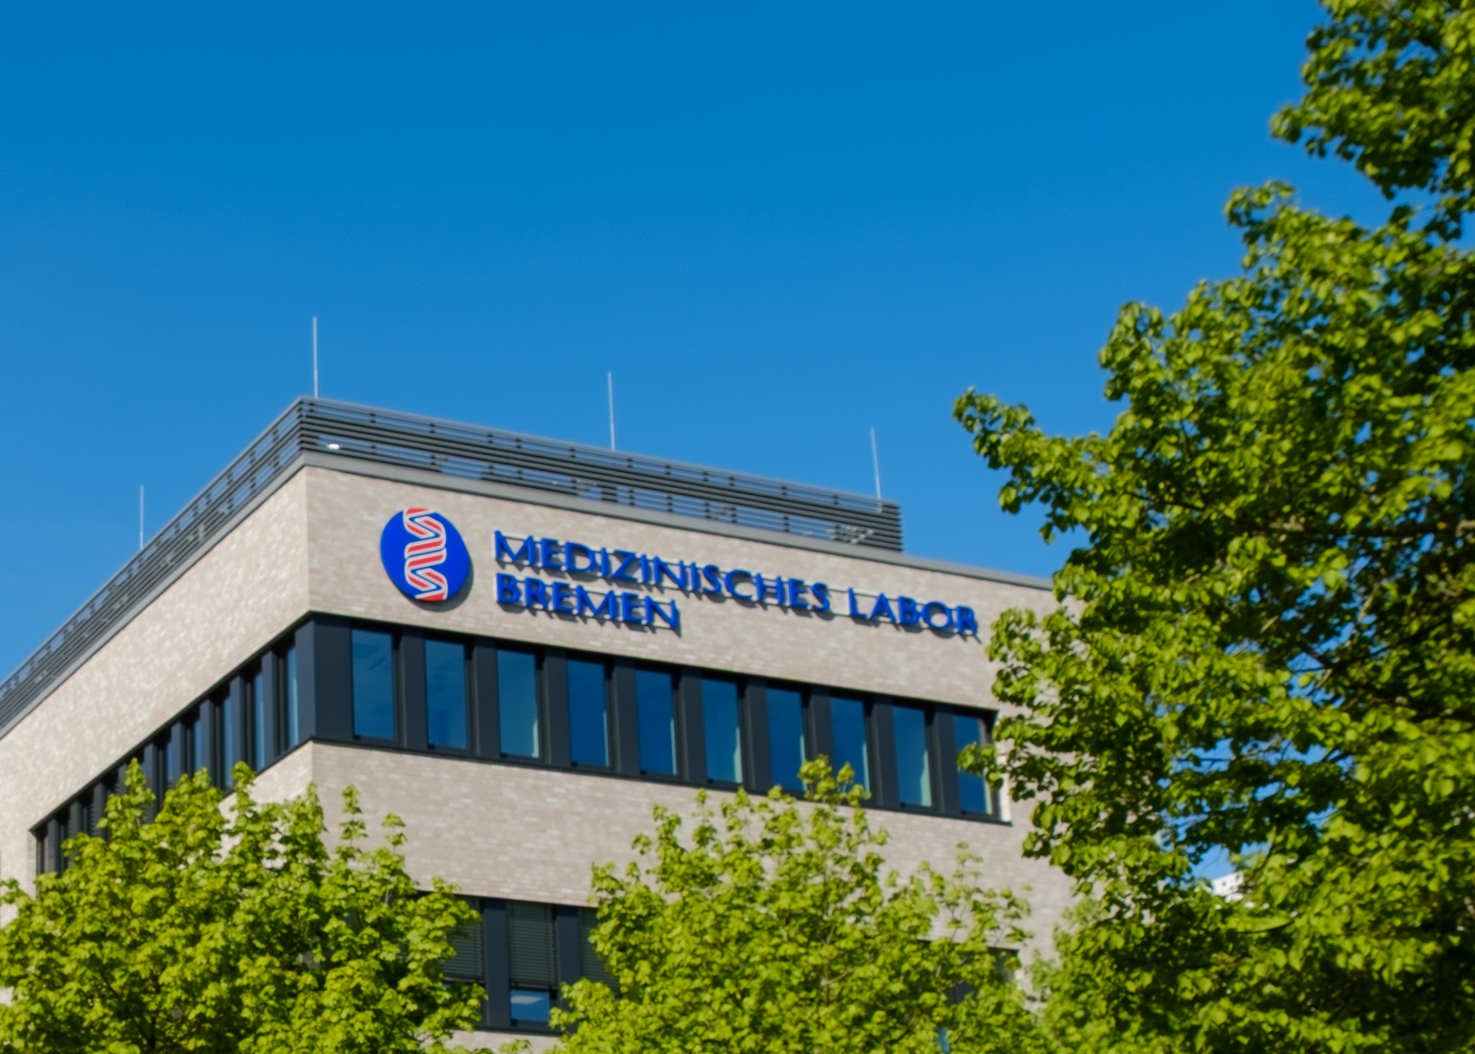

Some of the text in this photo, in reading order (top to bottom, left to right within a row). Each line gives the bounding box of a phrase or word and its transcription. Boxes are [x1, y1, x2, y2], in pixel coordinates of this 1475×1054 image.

[495, 530, 979, 636] MEDIZINISCHES LABOR
[495, 572, 681, 629] BREMEN
